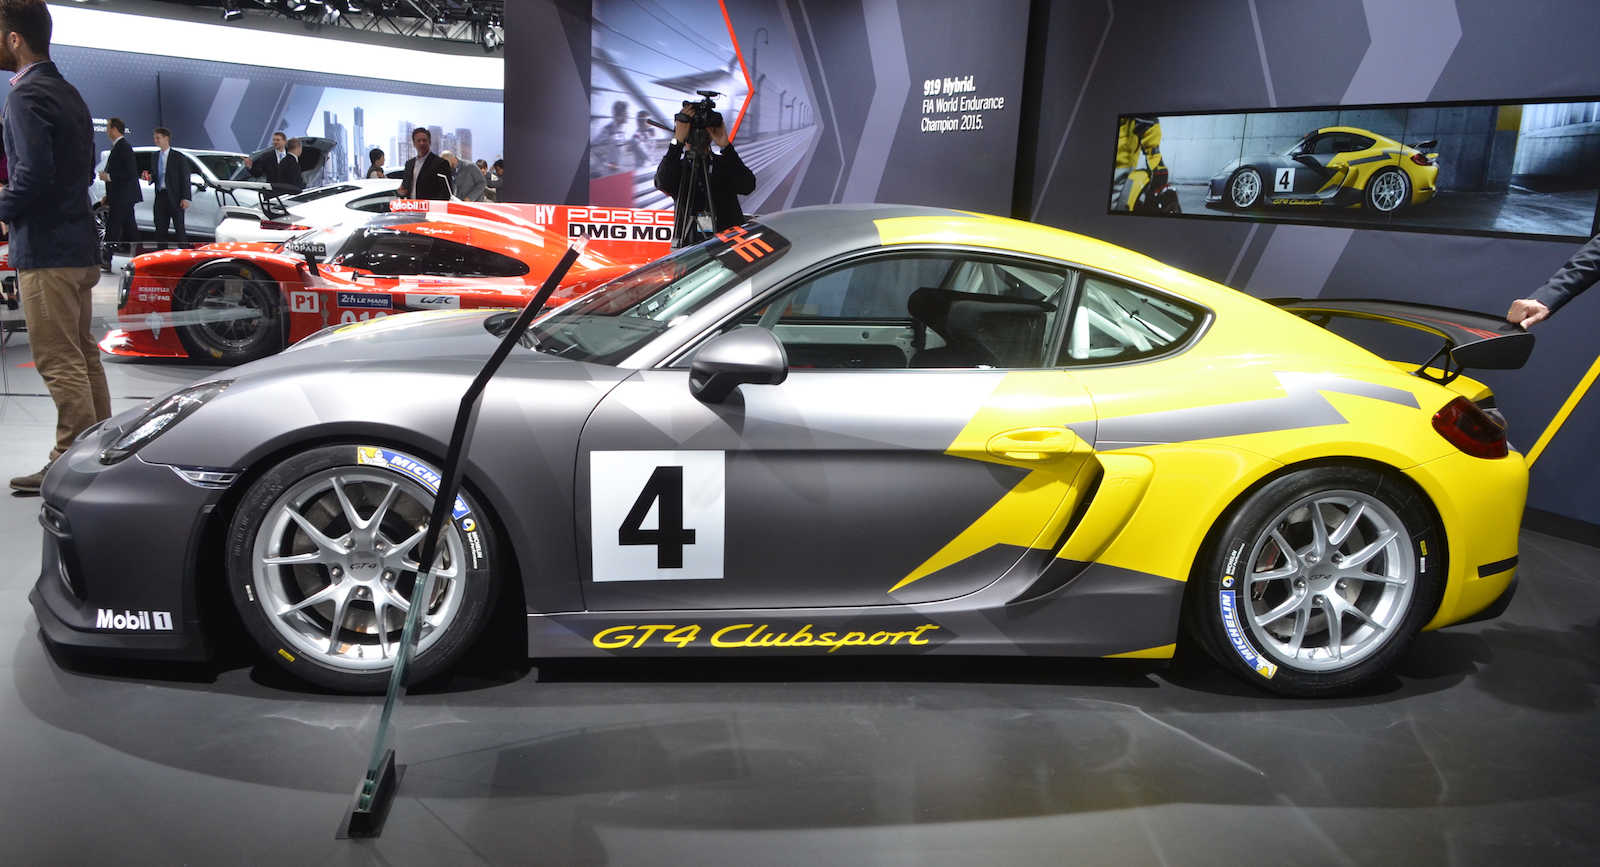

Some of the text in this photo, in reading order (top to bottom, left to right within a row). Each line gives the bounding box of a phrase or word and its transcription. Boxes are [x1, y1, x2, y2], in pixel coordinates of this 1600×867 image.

[923, 75, 976, 97] 919 Hybrid.
[922, 95, 1005, 114] FIA World Endurance
[921, 114, 984, 134] Champion 2015.
[1279, 170, 1290, 190] 4
[392, 199, 419, 210] Mobil
[535, 205, 556, 225] HY
[567, 208, 675, 224] PORSC
[569, 223, 672, 241] DMG MO
[295, 292, 315, 310] P1
[367, 298, 389, 306] MANS
[420, 295, 454, 304] WEC
[618, 465, 696, 569] 4
[96, 608, 151, 630] Mobil
[1221, 594, 1256, 661] MICHELIN
[592, 623, 940, 653] GT4 Clubsport
